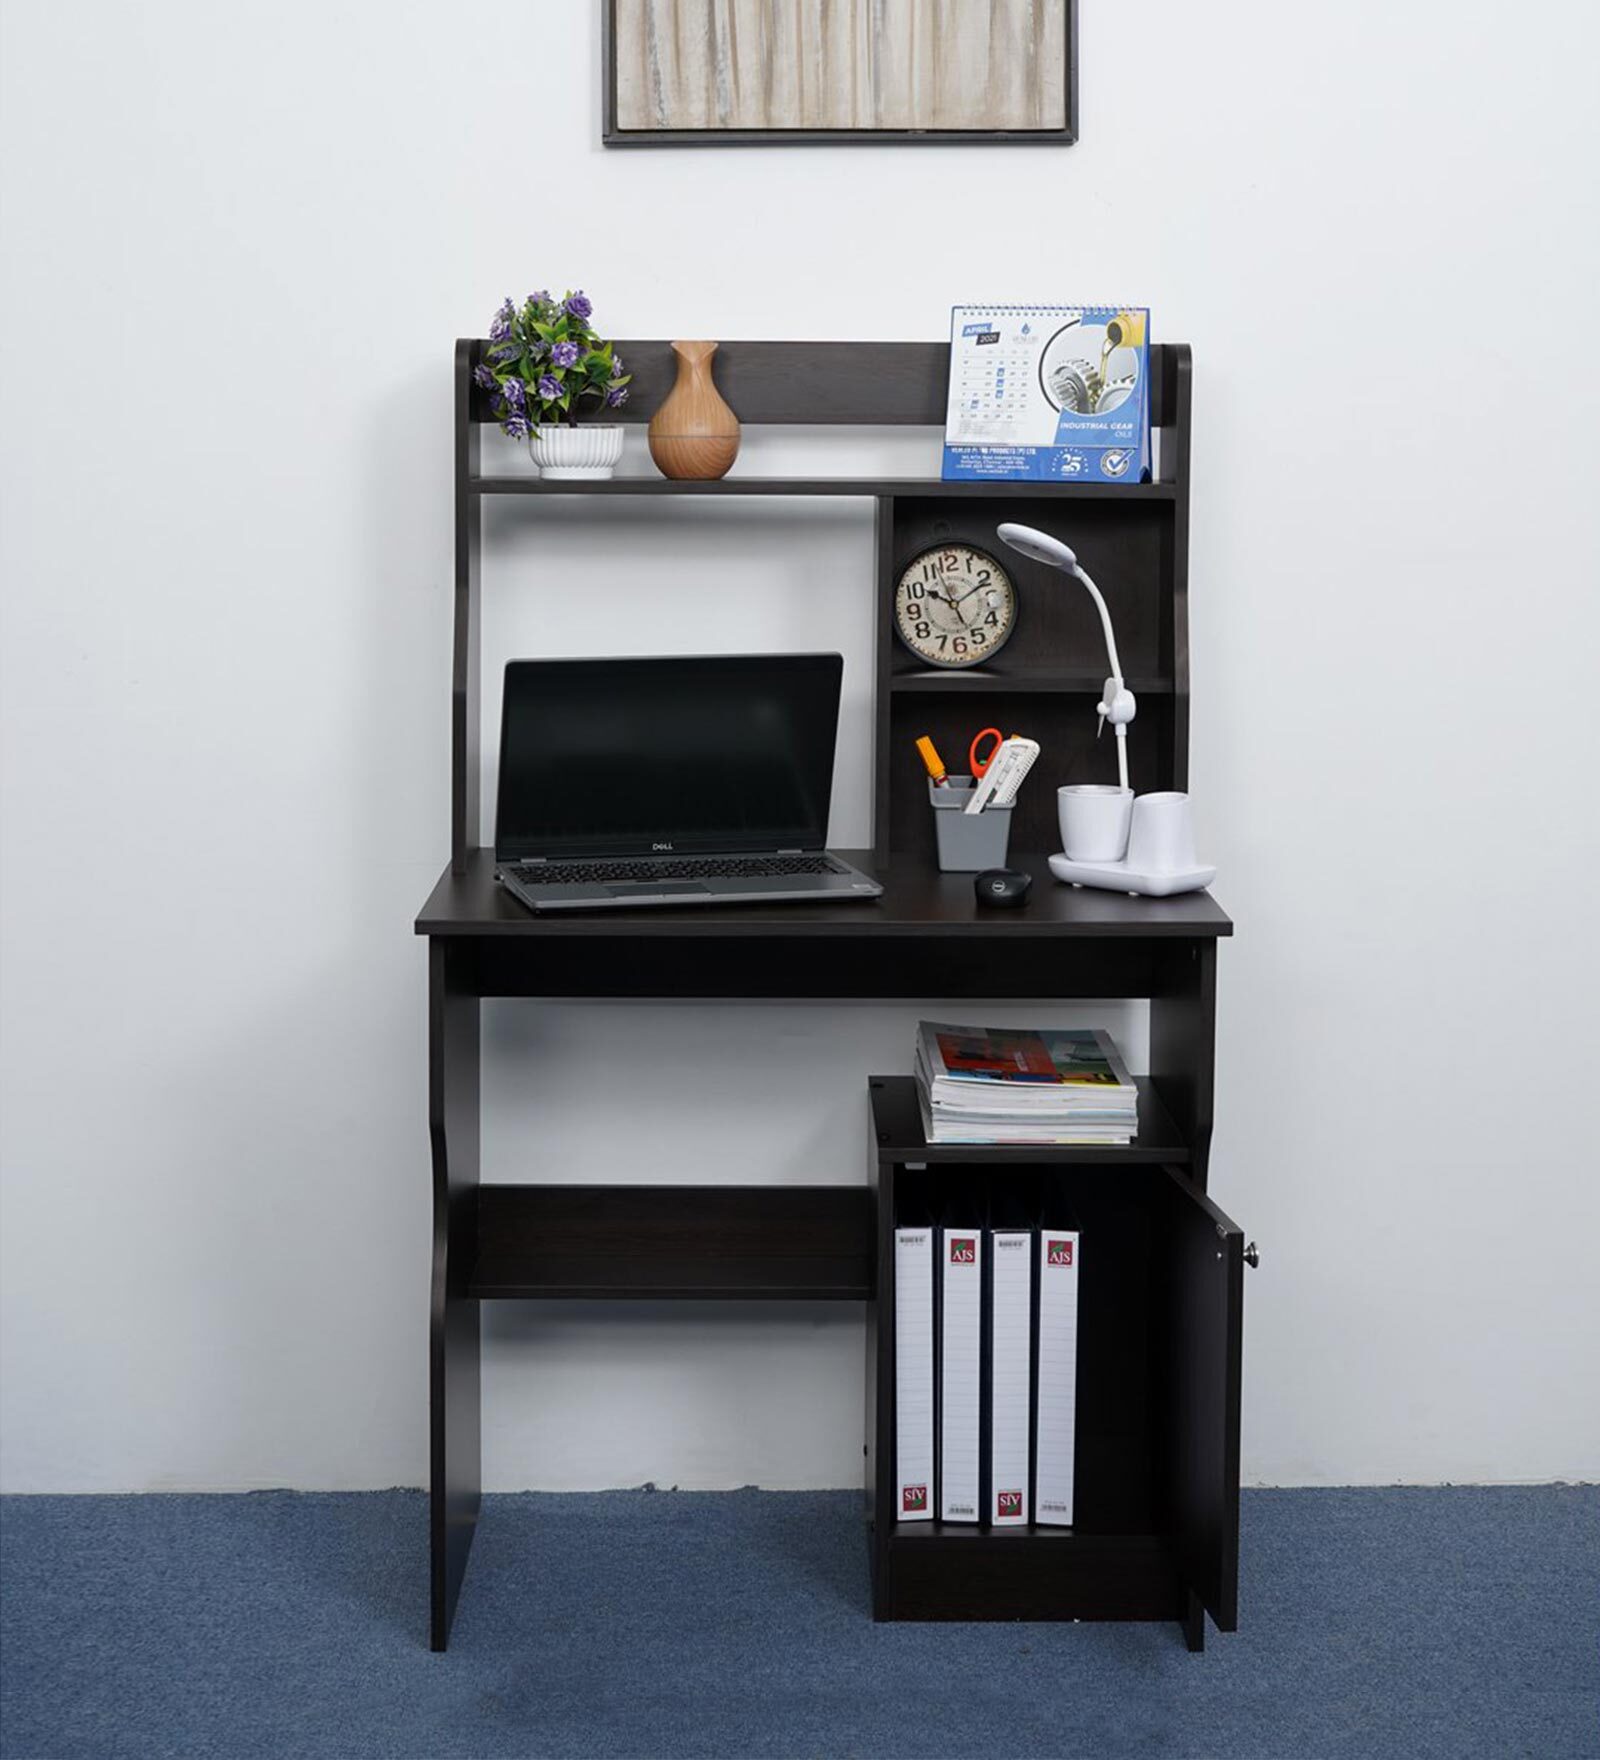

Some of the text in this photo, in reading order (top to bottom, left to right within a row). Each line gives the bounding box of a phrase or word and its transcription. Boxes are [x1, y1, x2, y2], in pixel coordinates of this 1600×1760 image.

[1060, 422, 1133, 430] INDUSTRIAL GEAR
[1061, 453, 1082, 472] 25
[923, 563, 937, 582] 11
[938, 554, 960, 574] 12
[976, 570, 992, 587] 2
[906, 582, 925, 600] 10
[906, 603, 922, 620] 9
[984, 611, 999, 626] 4
[915, 621, 930, 639] 8
[970, 628, 986, 645] 5
[934, 634, 948, 652] 7
[952, 636, 968, 654] 6
[952, 1249, 973, 1262] AJS
[1050, 1251, 1071, 1263] AJS
[904, 1487, 925, 1501] AJS
[1000, 1494, 1021, 1506] AJS
